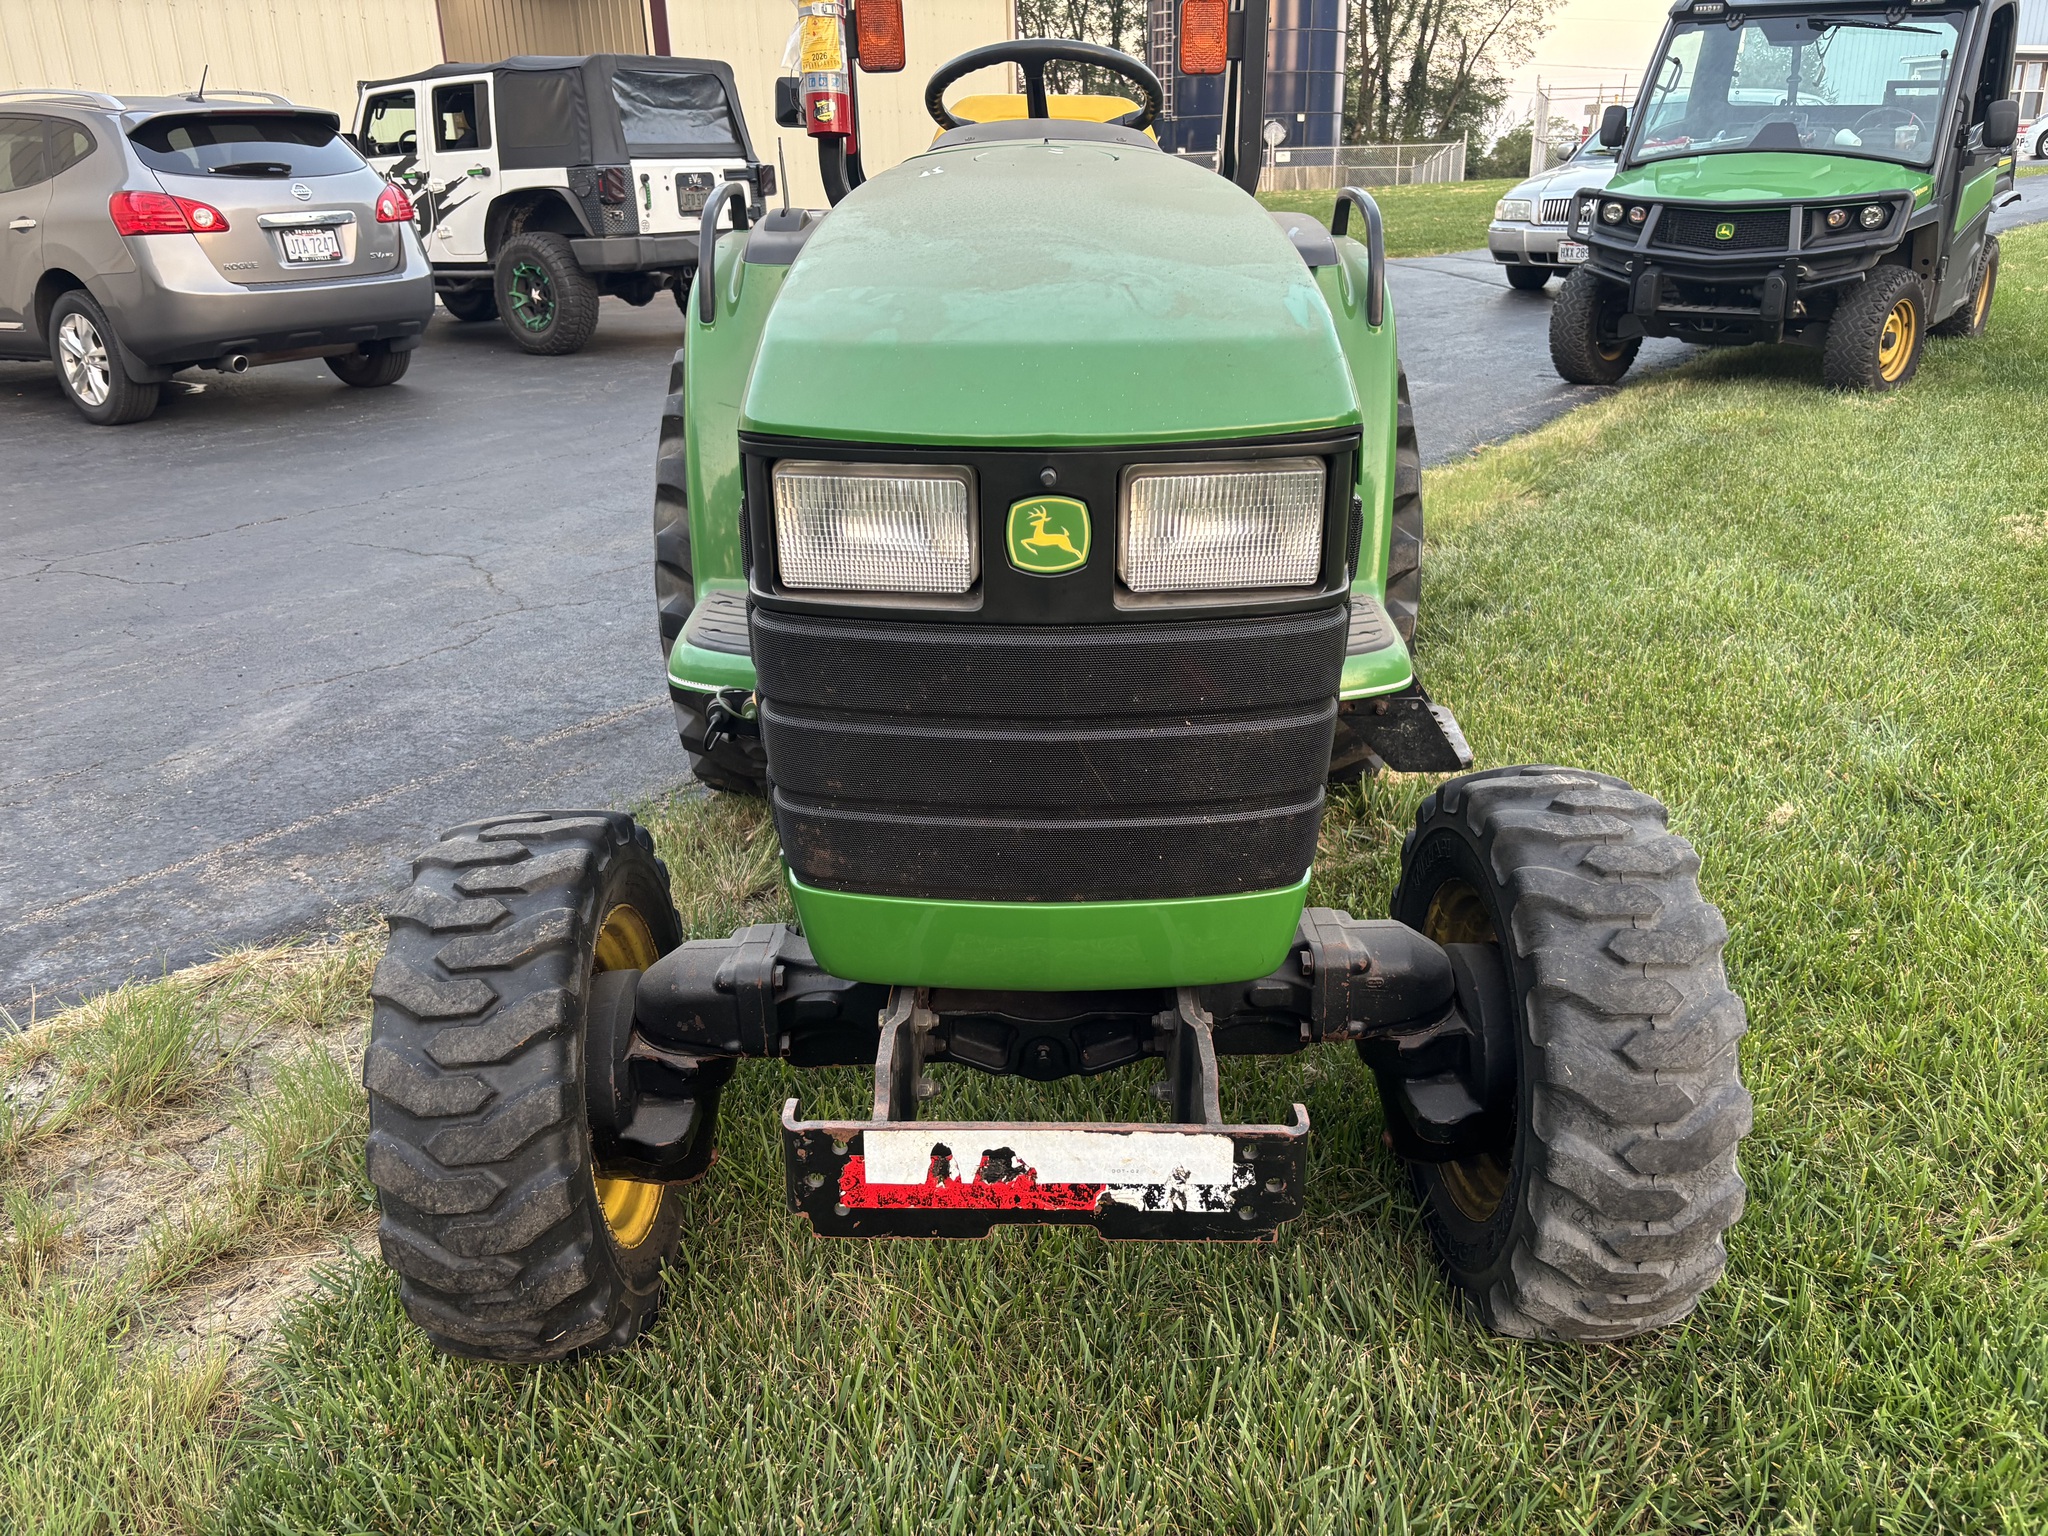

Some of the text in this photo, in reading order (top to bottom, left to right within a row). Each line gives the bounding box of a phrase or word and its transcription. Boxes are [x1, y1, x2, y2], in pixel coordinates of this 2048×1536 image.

[811, 52, 828, 61] 2026
[290, 236, 335, 254] JIA 7247
[223, 261, 259, 270] ROGUE
